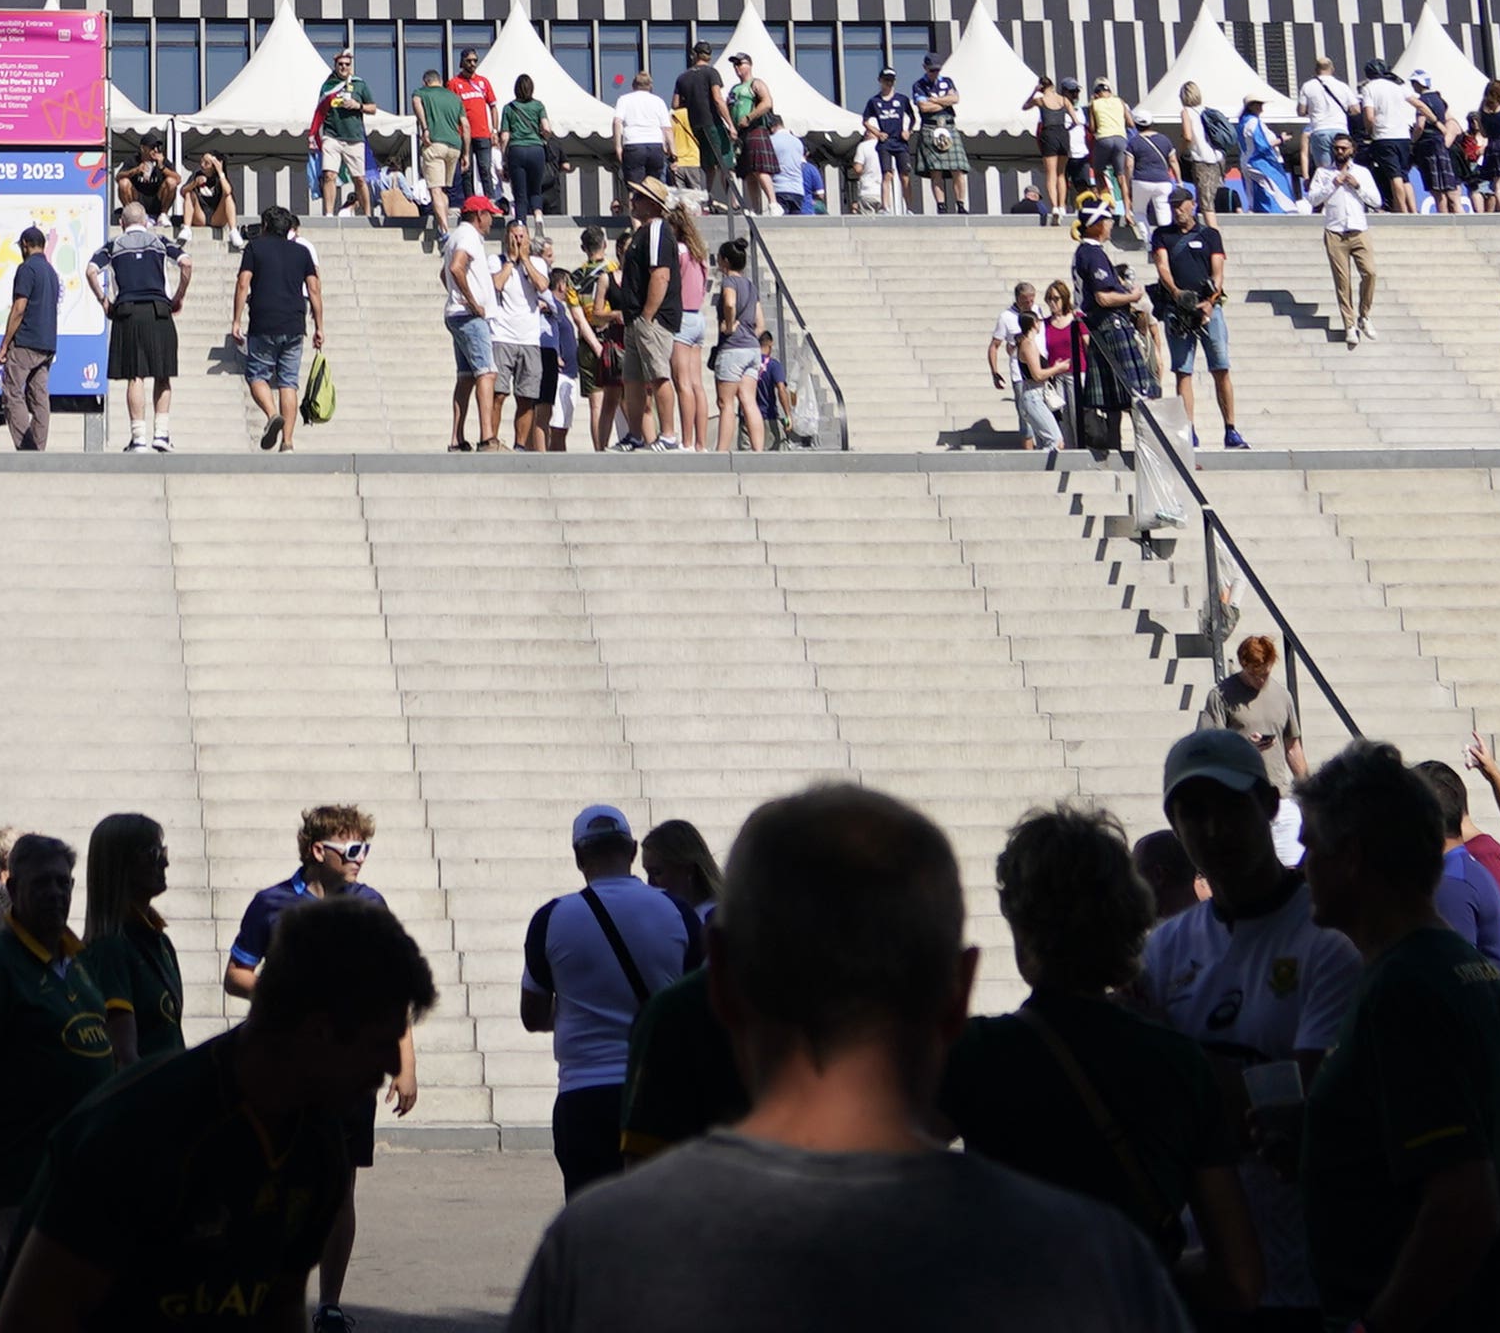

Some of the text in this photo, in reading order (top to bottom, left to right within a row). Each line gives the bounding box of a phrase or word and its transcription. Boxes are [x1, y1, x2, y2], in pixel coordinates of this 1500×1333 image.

[7, 27, 25, 35] Office
[18, 62, 39, 71] Access
[23, 70, 44, 79] Access
[45, 71, 60, 79] Gate
[9, 86, 27, 94] Gates
[4, 94, 33, 103] Beverage
[22, 163, 65, 180] 2023
